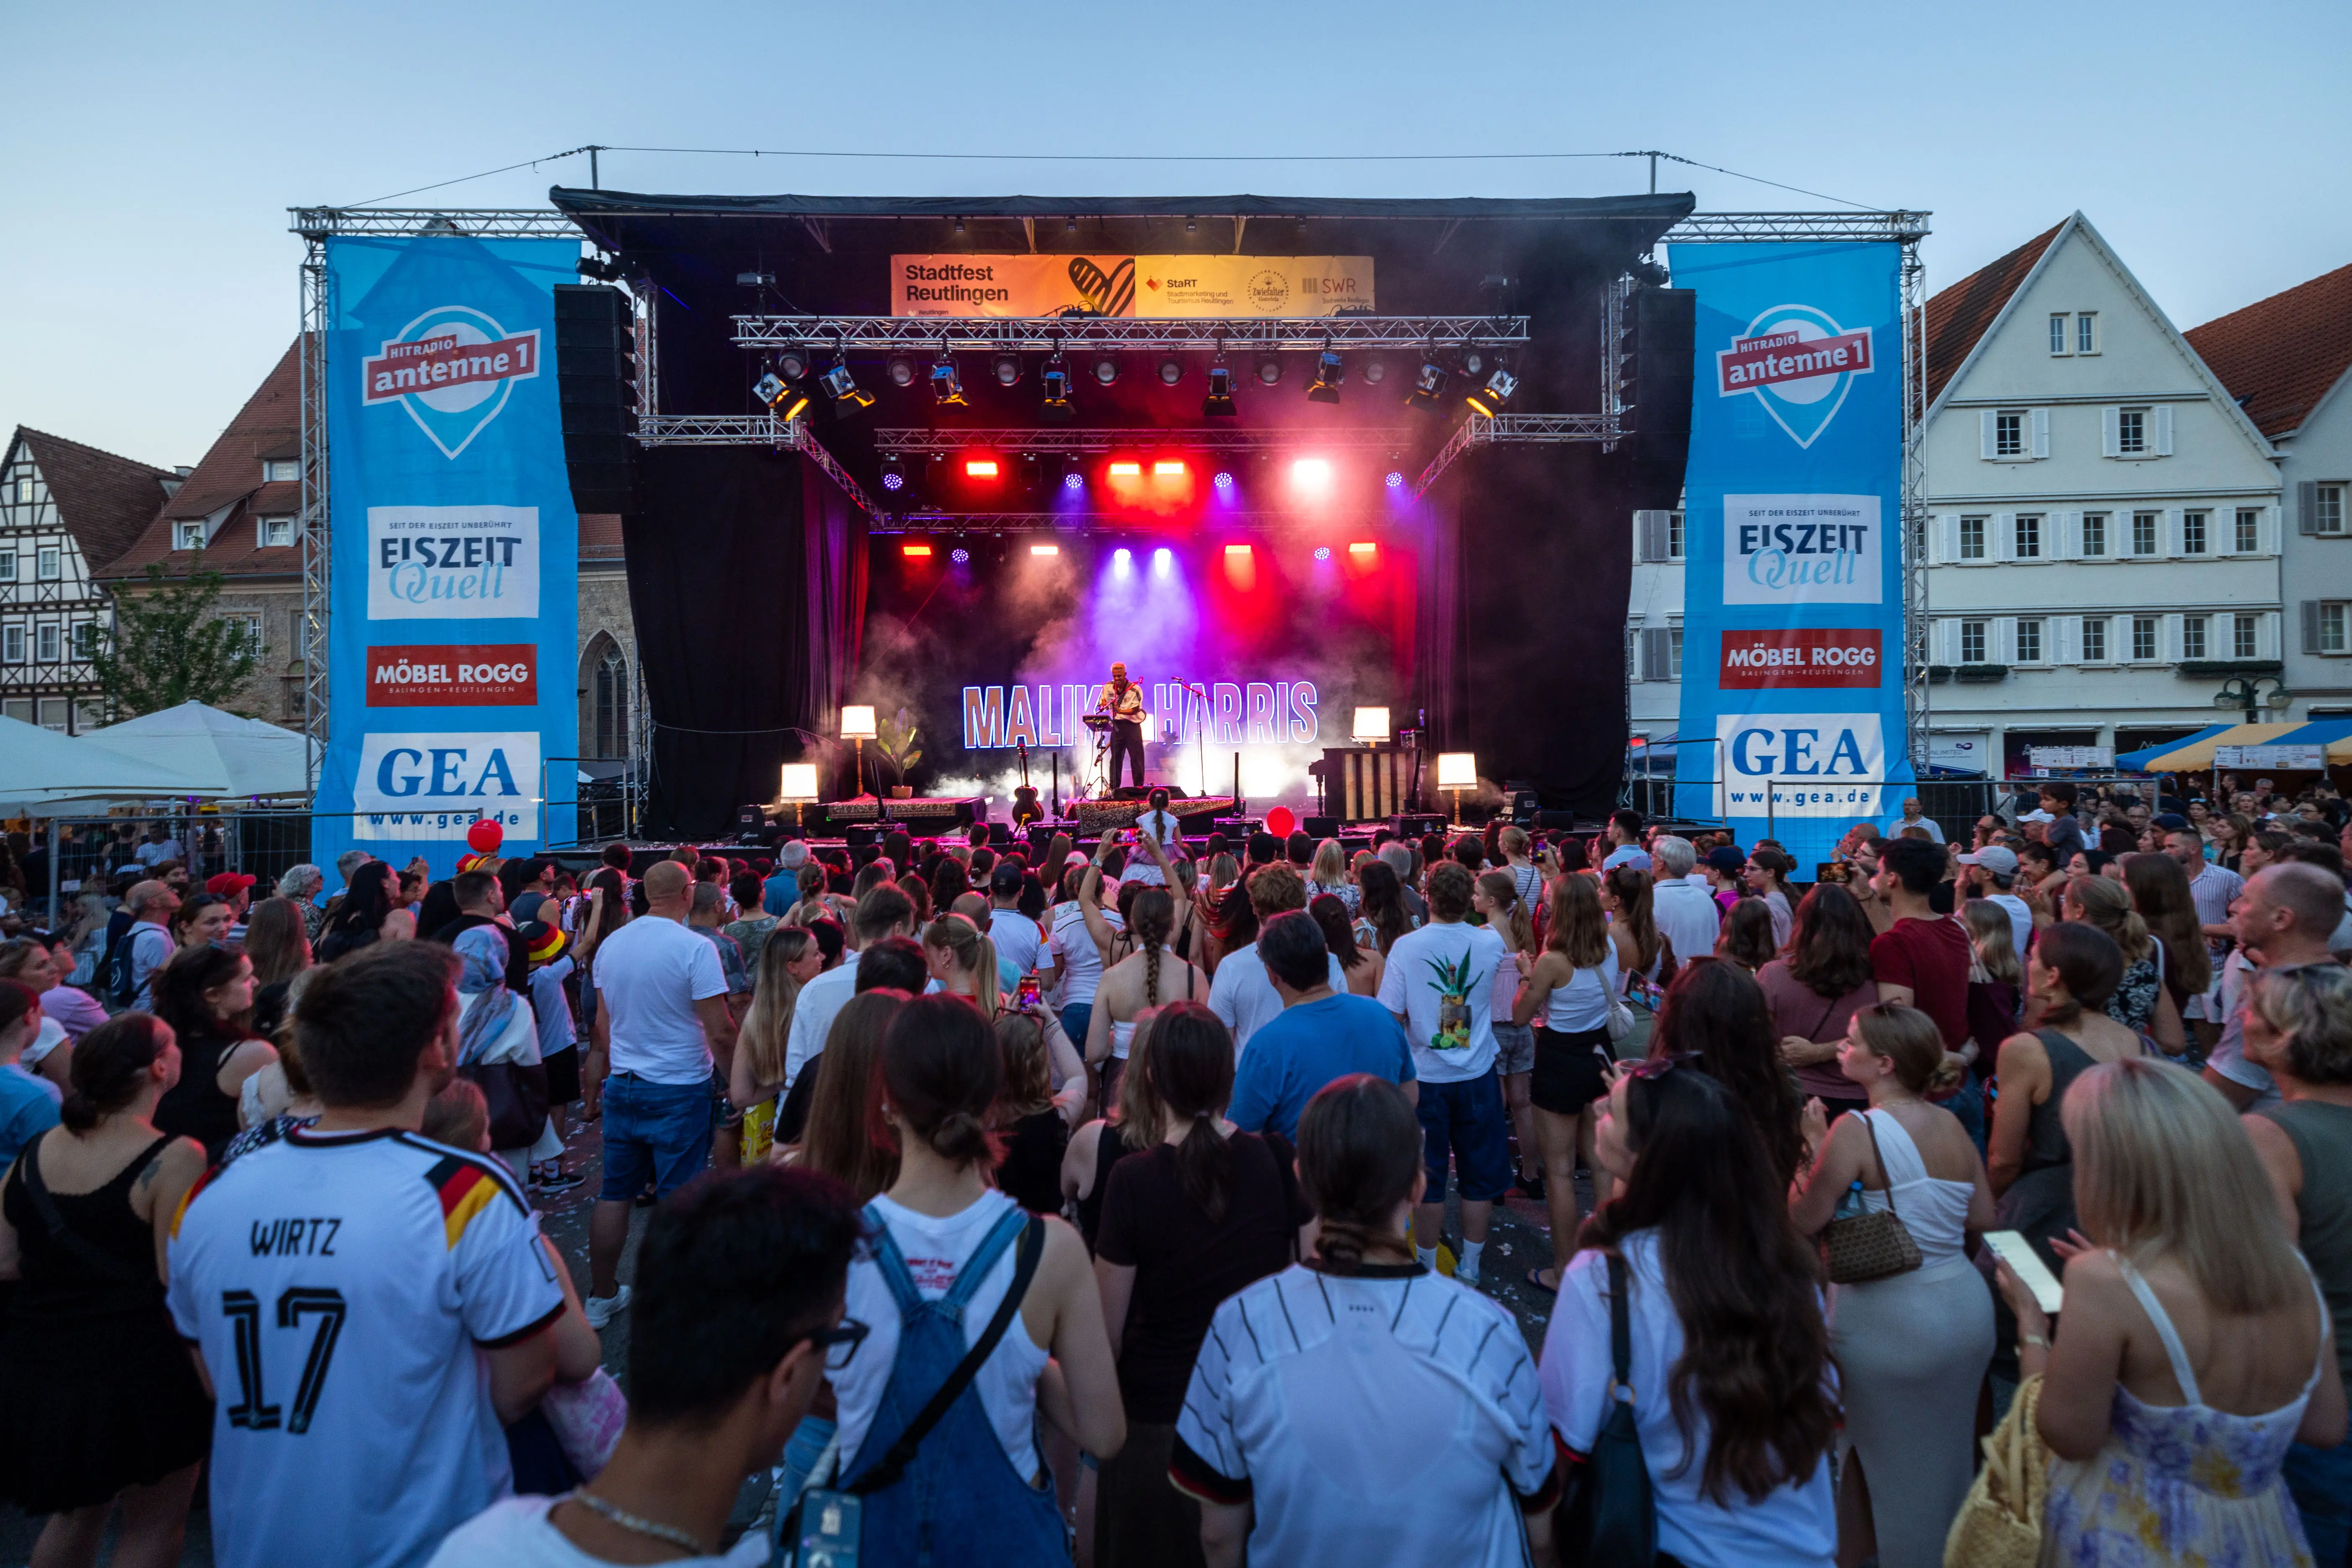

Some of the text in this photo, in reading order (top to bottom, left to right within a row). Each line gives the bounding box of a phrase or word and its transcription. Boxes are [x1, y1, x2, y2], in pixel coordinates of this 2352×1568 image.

[906, 264, 994, 281] Stadtfest
[907, 285, 1008, 305] Reutlingen
[1253, 286, 1284, 296] Zwiefalter
[1322, 278, 1356, 294] SWR
[390, 339, 453, 359] HITRADIO
[1740, 335, 1796, 353] HITRADIO
[375, 343, 528, 392] antenne 1
[1729, 340, 1864, 384] antenne 1
[462, 520, 513, 529] UNBERÜHRT
[1817, 509, 1861, 517] UNBERÜHRT
[381, 537, 522, 568] EISZEIT
[1739, 524, 1868, 555] EISZEIT
[1748, 546, 1857, 590] Quell
[389, 559, 505, 604] Quell
[1727, 643, 1876, 667] MÖBEL ROGG
[375, 658, 528, 684] MÖBEL ROGG
[962, 681, 1319, 749] MALIK HARRIS
[1732, 728, 1869, 776] GEA
[377, 748, 522, 797] GEA
[1731, 788, 1869, 806] www.gea.de
[370, 811, 519, 829] www.geade
[251, 1218, 342, 1257] WIRTZ
[222, 1286, 347, 1436] 17
